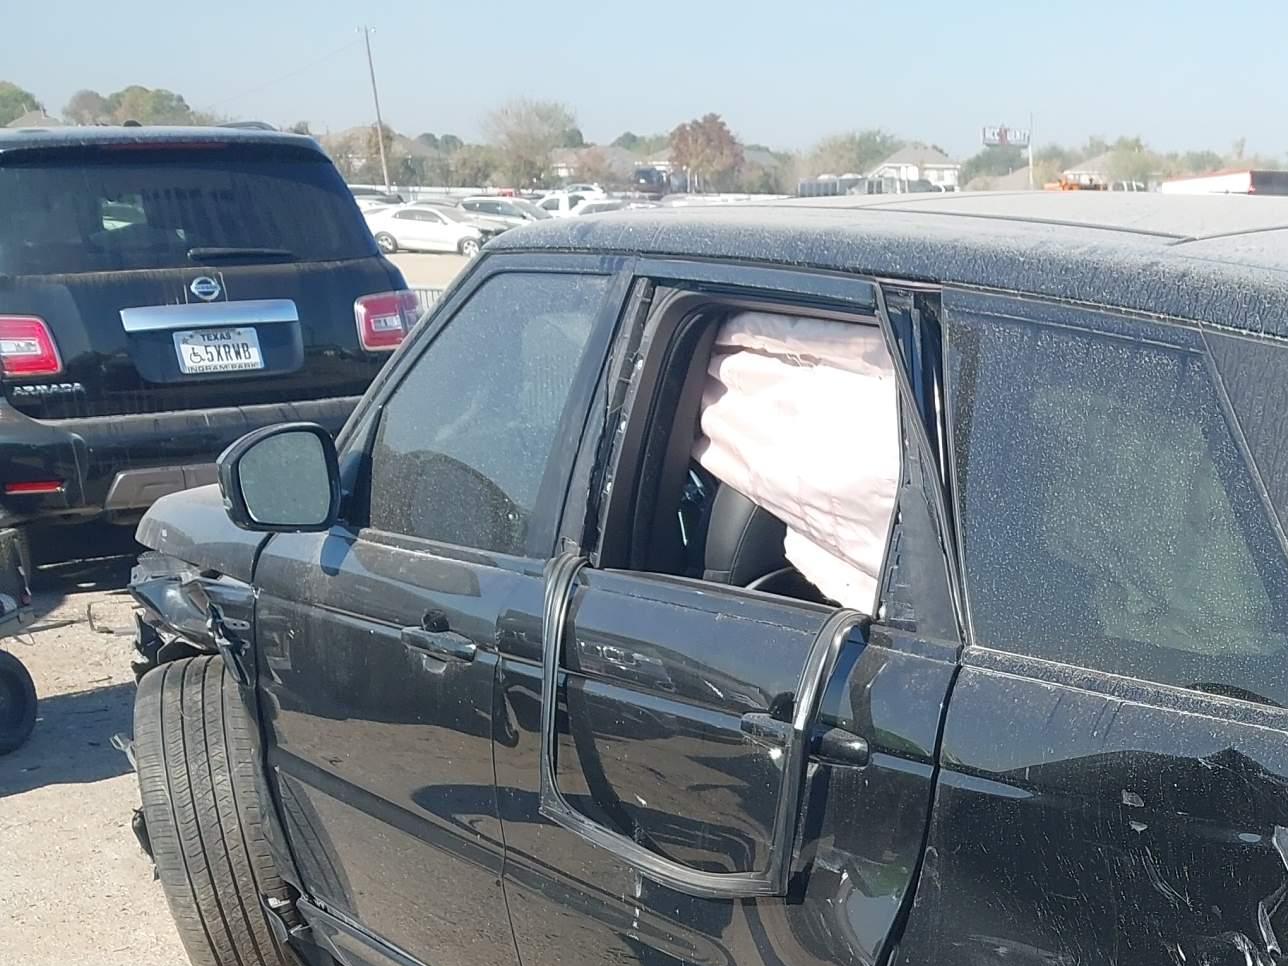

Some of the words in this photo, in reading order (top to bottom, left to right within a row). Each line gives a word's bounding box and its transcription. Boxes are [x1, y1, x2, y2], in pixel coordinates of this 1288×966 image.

[201, 331, 232, 342] TEXAS
[204, 342, 252, 362] 5XRWB
[13, 382, 87, 396] ARMADA
